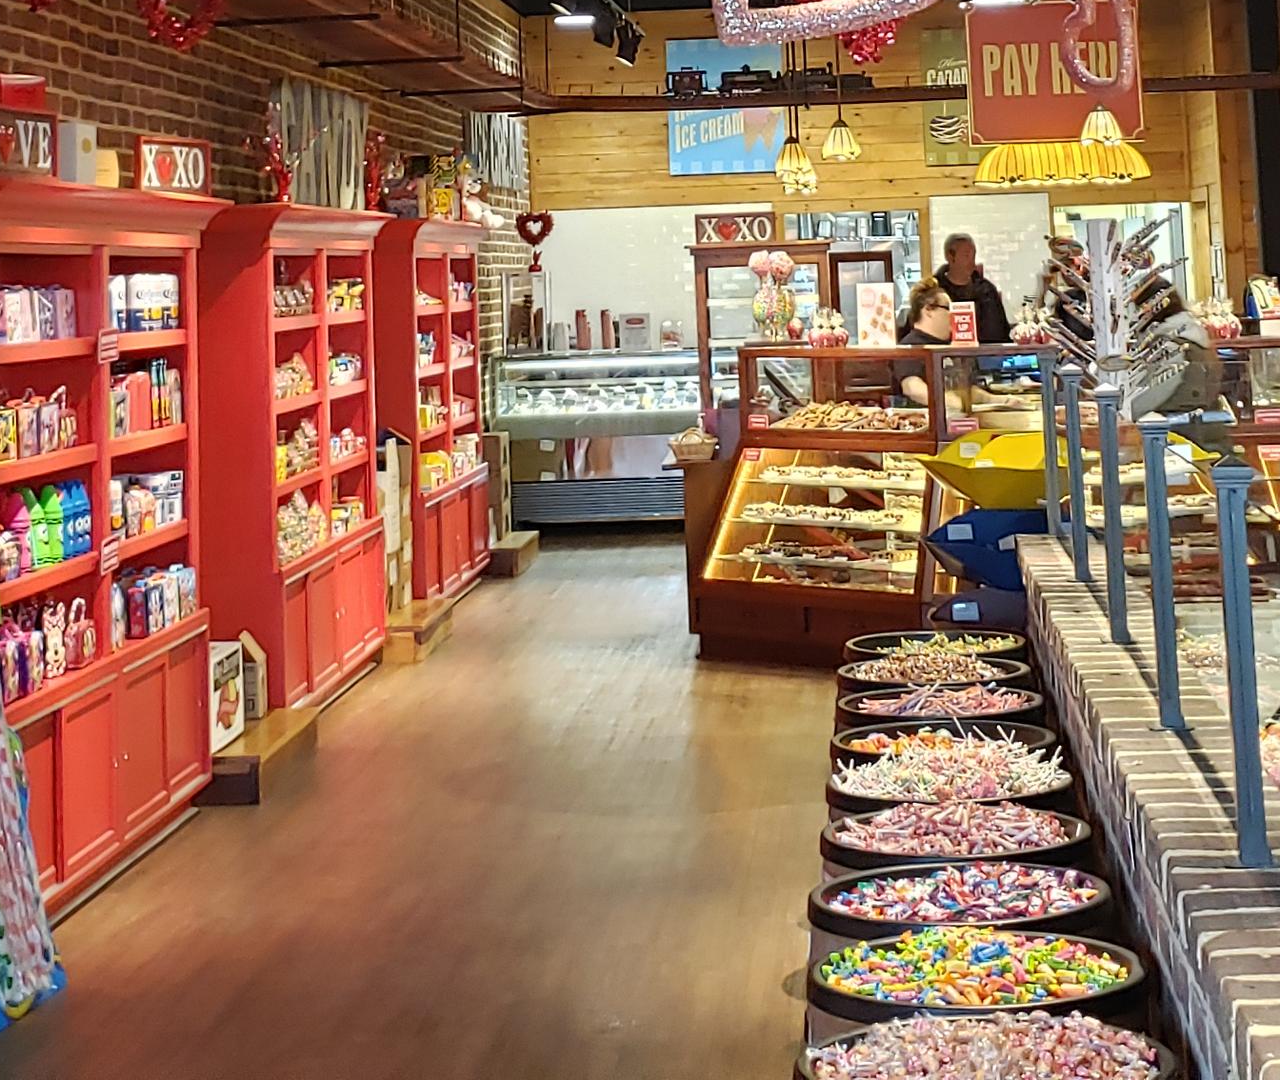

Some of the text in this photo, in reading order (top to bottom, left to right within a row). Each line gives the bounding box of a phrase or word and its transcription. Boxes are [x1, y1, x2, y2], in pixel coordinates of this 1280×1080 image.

[982, 42, 1039, 97] PAY
[674, 111, 745, 153] ICE CREAM
